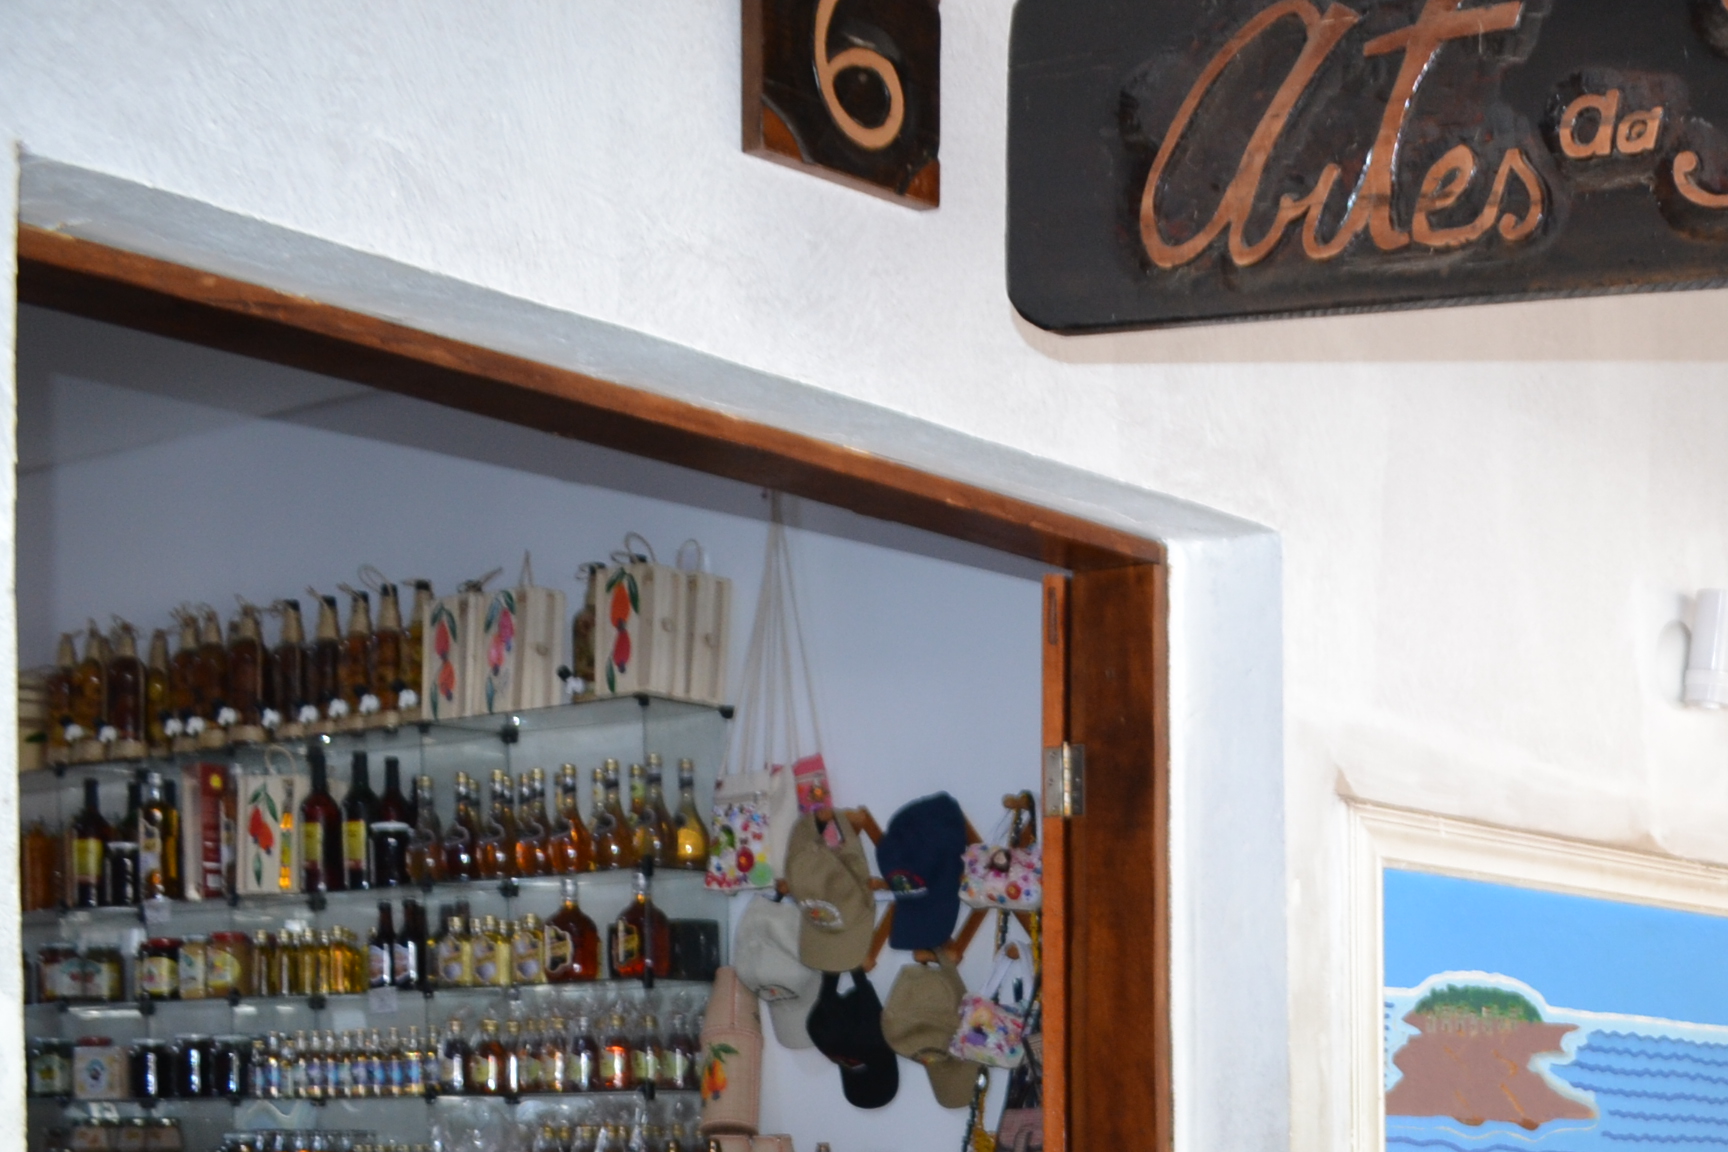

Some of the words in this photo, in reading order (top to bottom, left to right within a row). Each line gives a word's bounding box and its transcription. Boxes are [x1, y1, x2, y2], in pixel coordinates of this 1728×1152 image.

[814, 0, 905, 149] 6
[1139, 0, 1543, 268] Artes
[1559, 90, 1663, 159] da
